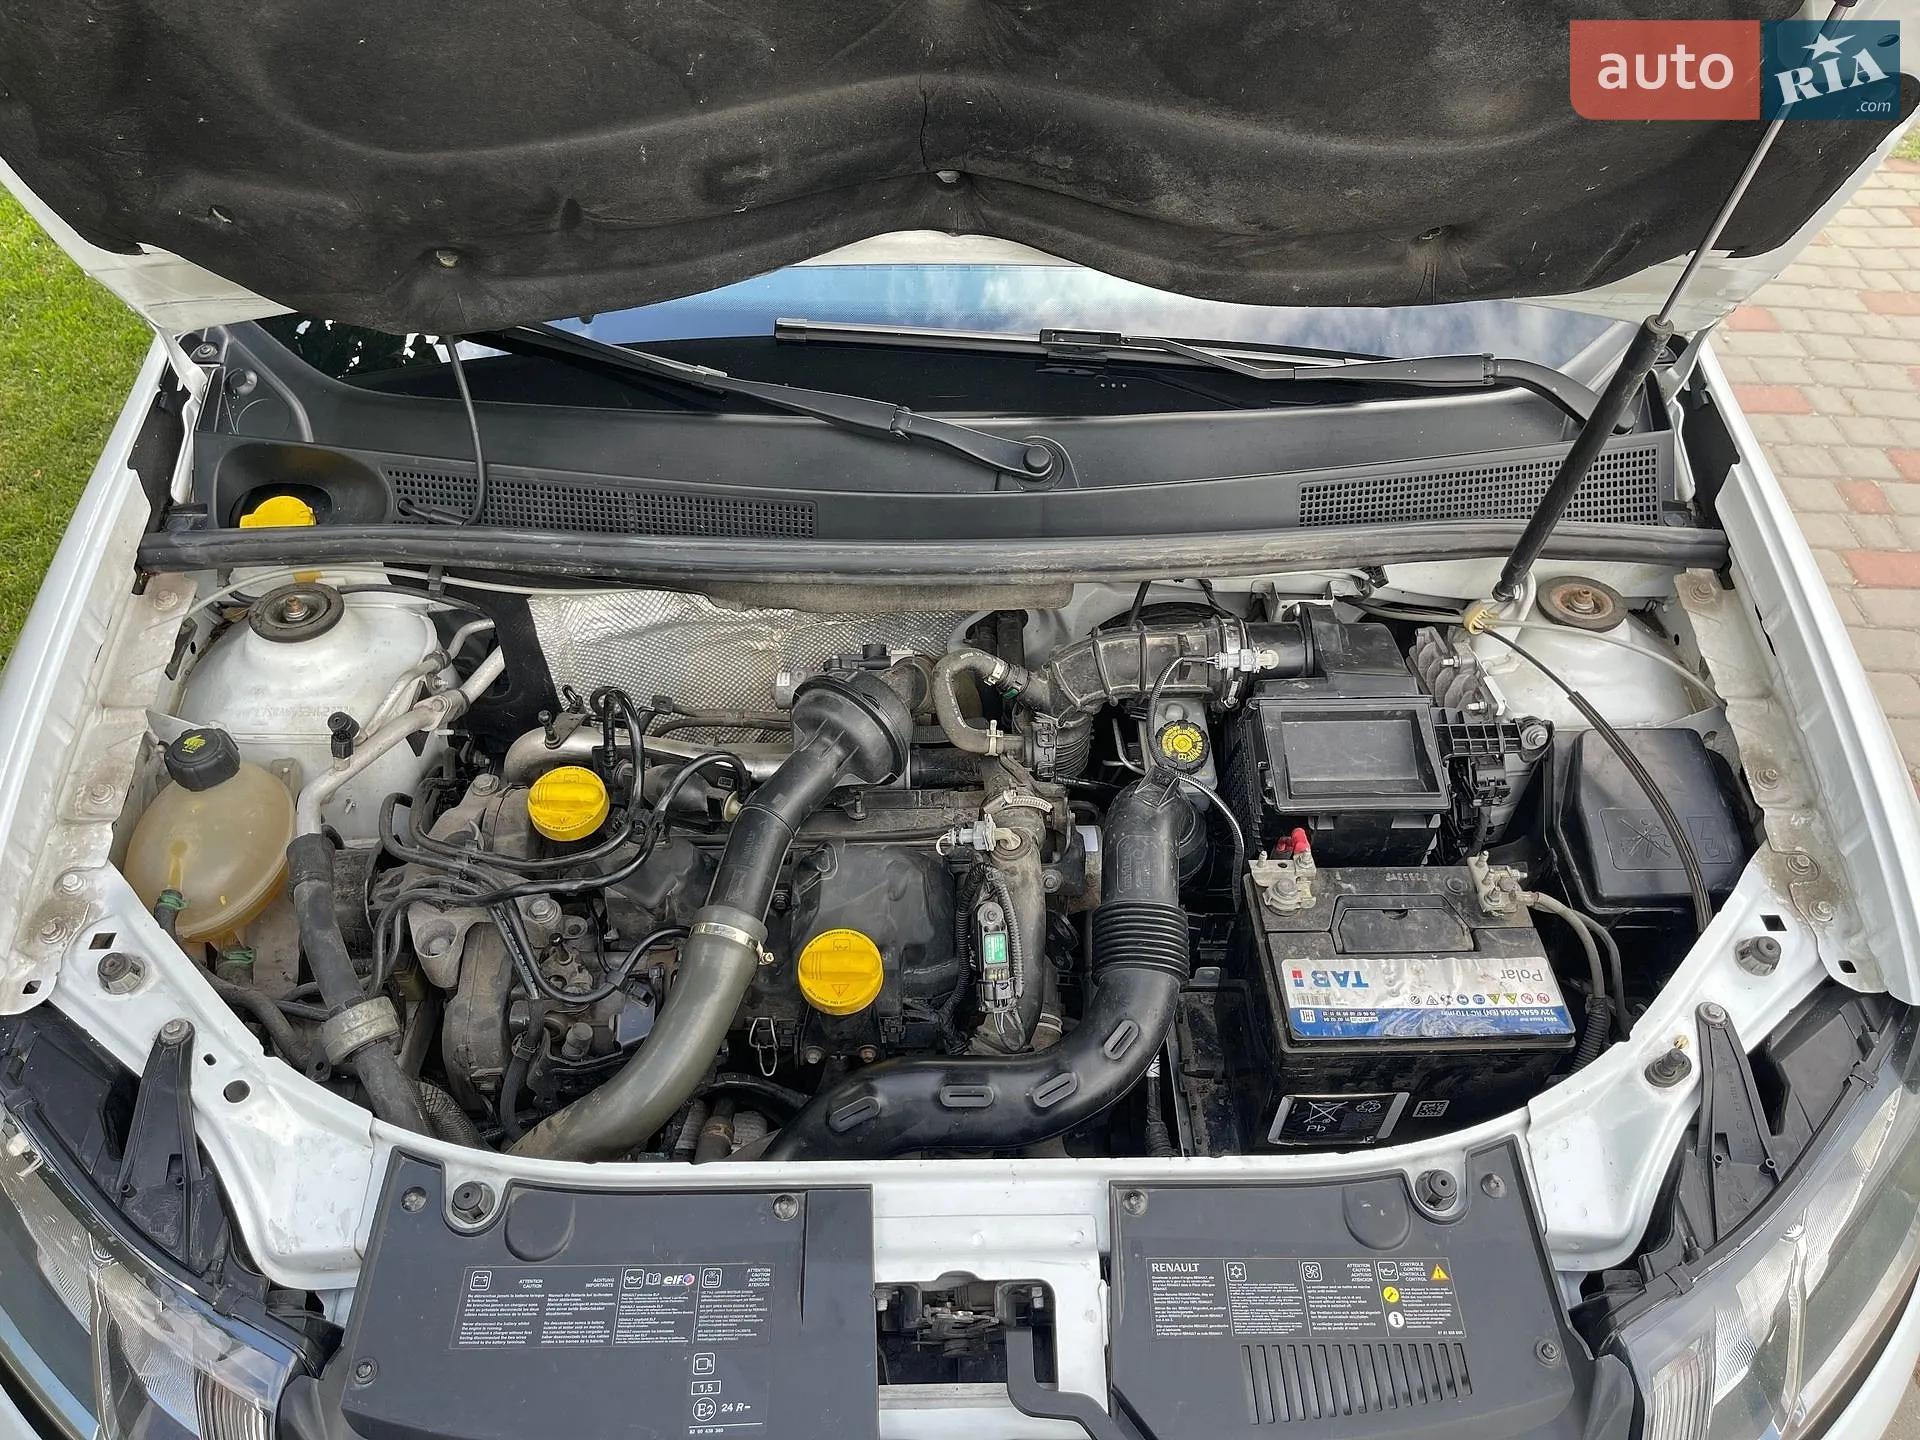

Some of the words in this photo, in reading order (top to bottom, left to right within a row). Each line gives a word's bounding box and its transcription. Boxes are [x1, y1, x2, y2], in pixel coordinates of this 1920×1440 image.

[1310, 969, 1369, 988] TAB
[1500, 968, 1543, 983] Polar
[1306, 1124, 1326, 1132] Pb
[1152, 1263, 1200, 1272] RENAULT
[663, 1274, 684, 1285] elf
[699, 1384, 713, 1393] 1,5
[697, 1403, 713, 1417] E2
[722, 1403, 733, 1412] 24
